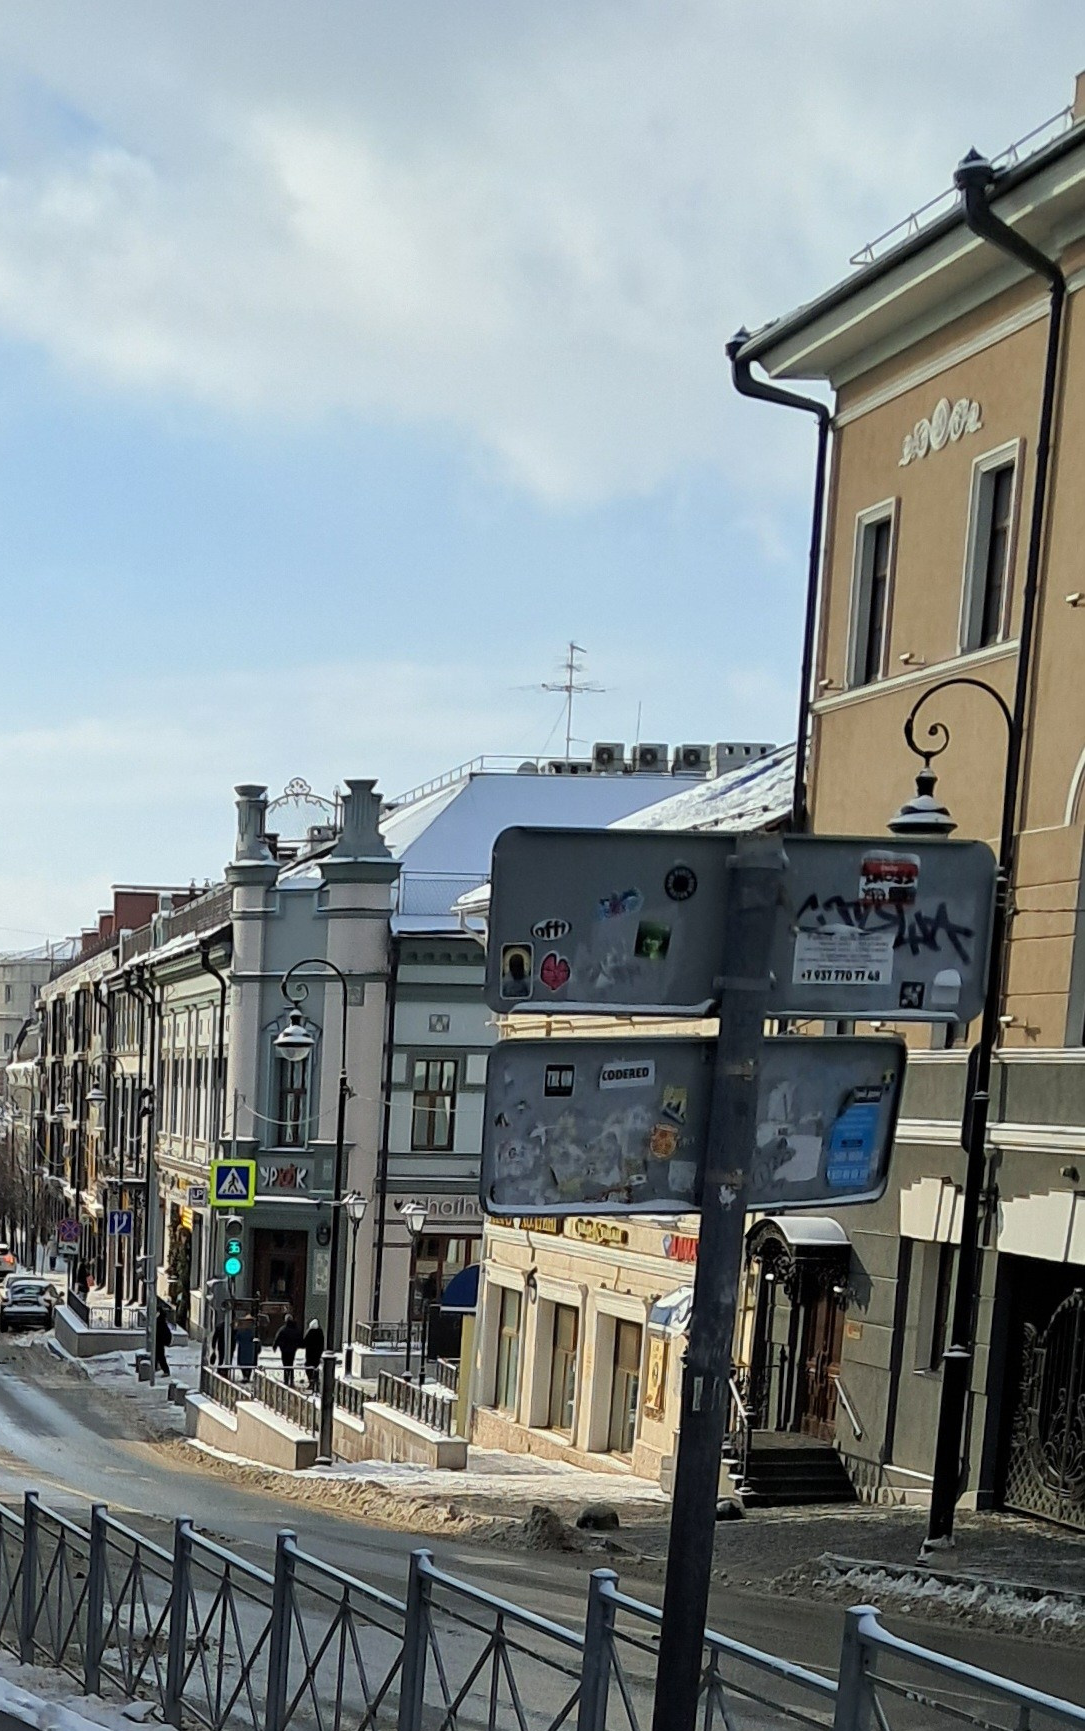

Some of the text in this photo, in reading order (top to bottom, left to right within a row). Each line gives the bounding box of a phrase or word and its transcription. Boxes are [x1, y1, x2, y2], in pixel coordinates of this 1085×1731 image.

[834, 969, 853, 981] 770
[855, 969, 866, 981] 77
[602, 1067, 649, 1081] CODERED
